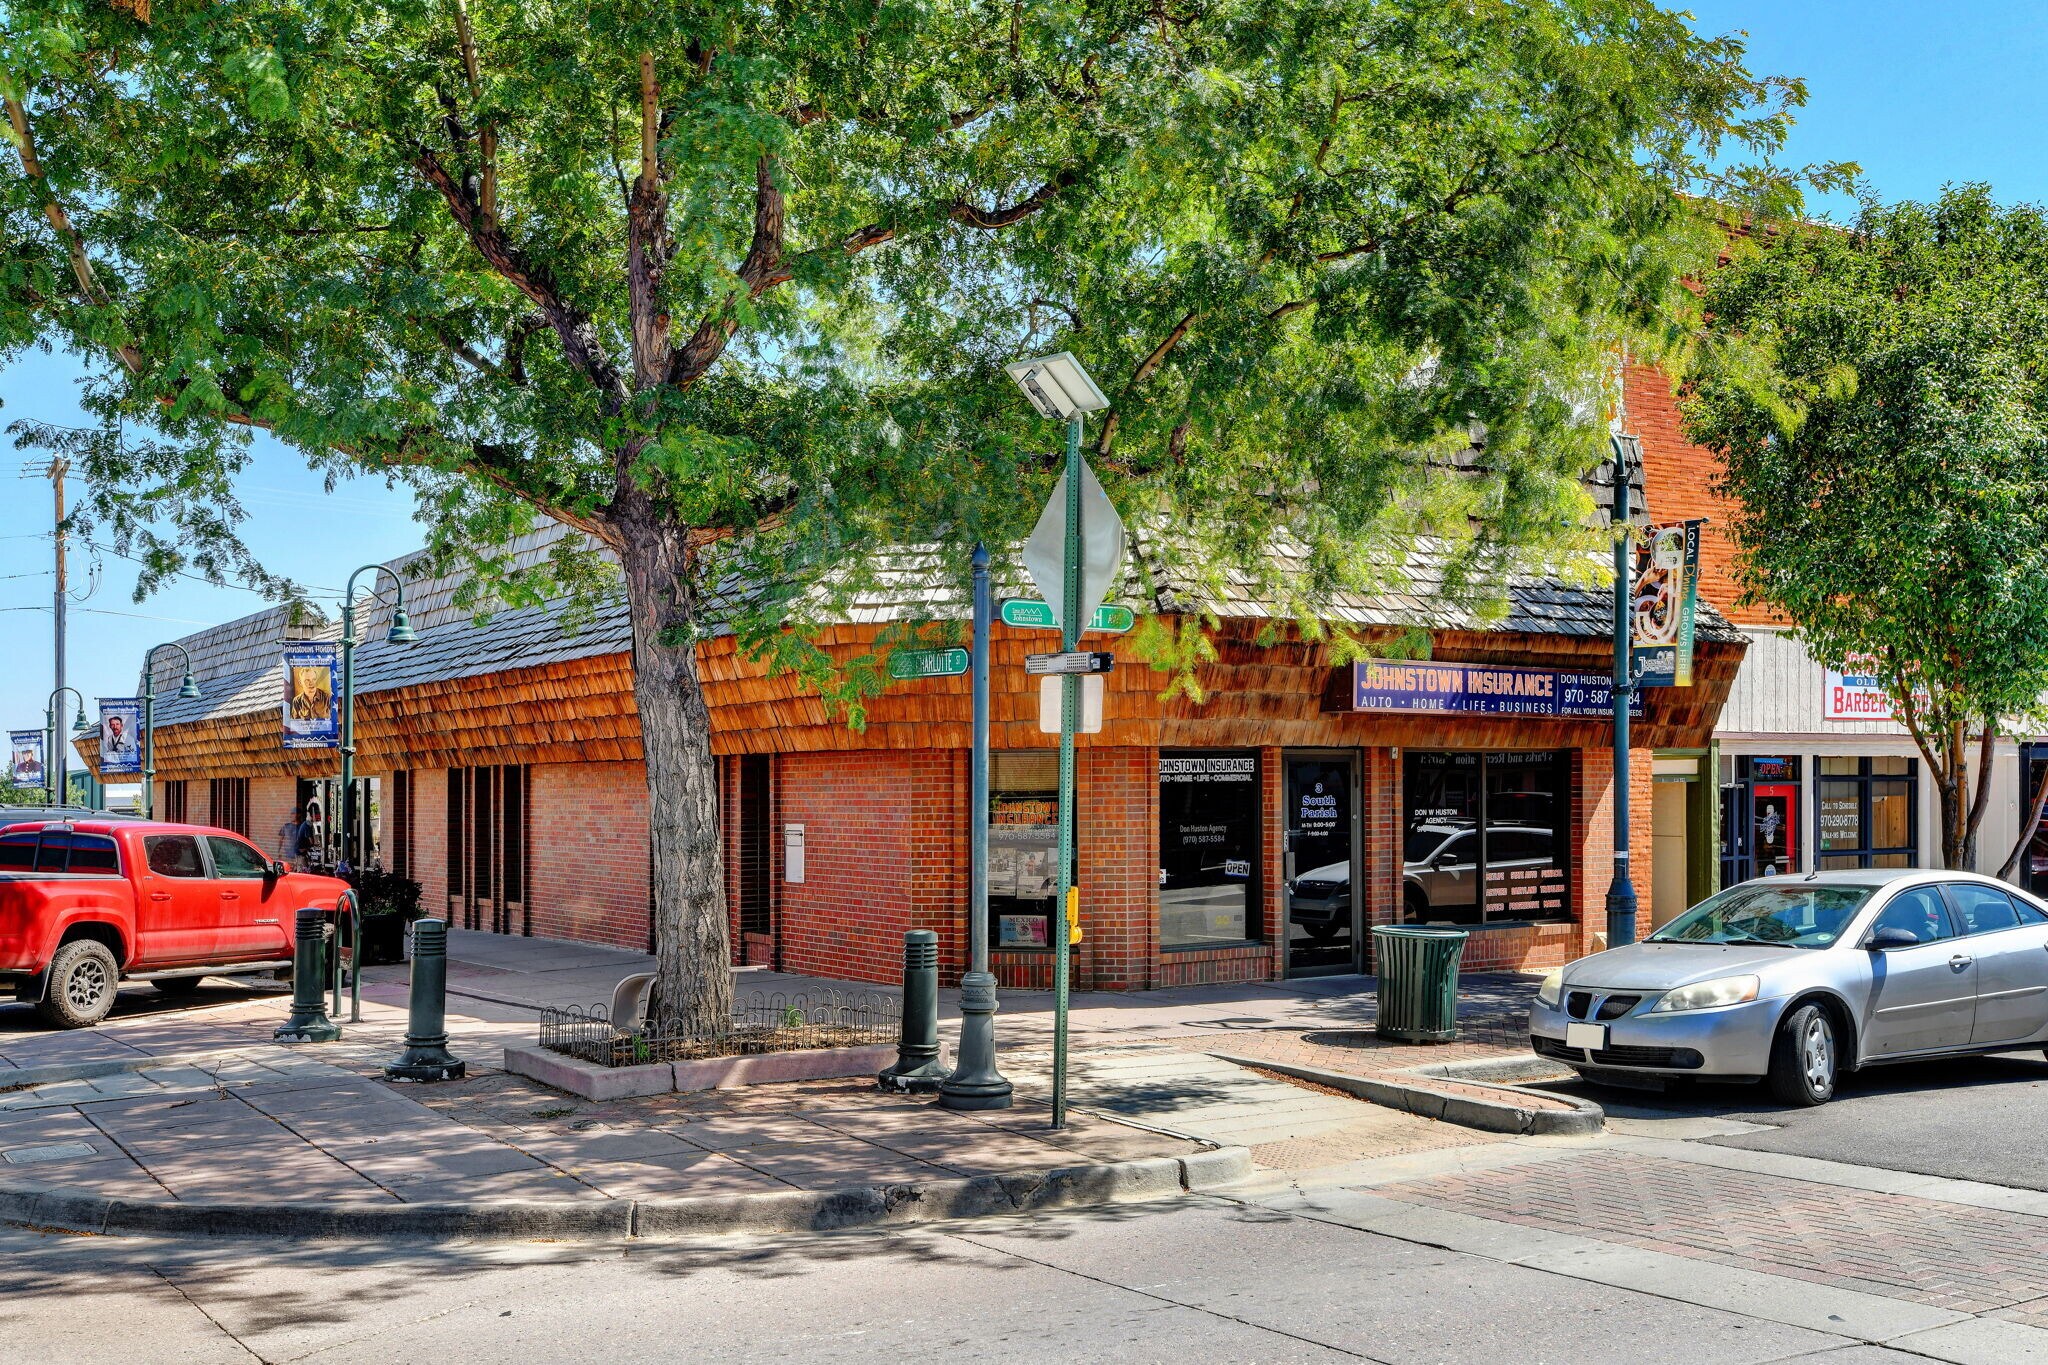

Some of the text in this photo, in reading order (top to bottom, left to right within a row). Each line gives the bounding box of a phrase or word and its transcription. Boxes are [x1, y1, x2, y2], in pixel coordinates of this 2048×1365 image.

[1686, 527, 1696, 561] LOCAL
[1012, 614, 1043, 623] Johnstown
[1680, 607, 1690, 647] GROWS
[955, 655, 960, 665] ST
[1679, 649, 1688, 676] HERE
[1361, 666, 1554, 697] JOHNSTOWN INSURANCE
[1560, 674, 1612, 686] DON HUSTON
[1361, 696, 1553, 713] AUTO HOME LIFE BUSINESS
[1833, 686, 1887, 714] BARBER
[1159, 759, 1254, 773] OHNSTOWN INSURANCE
[1761, 764, 1781, 774] OPEN
[1213, 774, 1252, 782] COMMERCIAL
[1315, 783, 1323, 793] 3
[1769, 786, 1774, 796] 5
[1302, 795, 1336, 805] South
[1301, 807, 1337, 818] Parish
[1435, 808, 1458, 816] HUSTON
[1820, 815, 1859, 827] 970-290-8778
[1209, 824, 1227, 833] Agency
[1183, 835, 1225, 845] (970) 587-5584
[1226, 862, 1250, 875] OPEN
